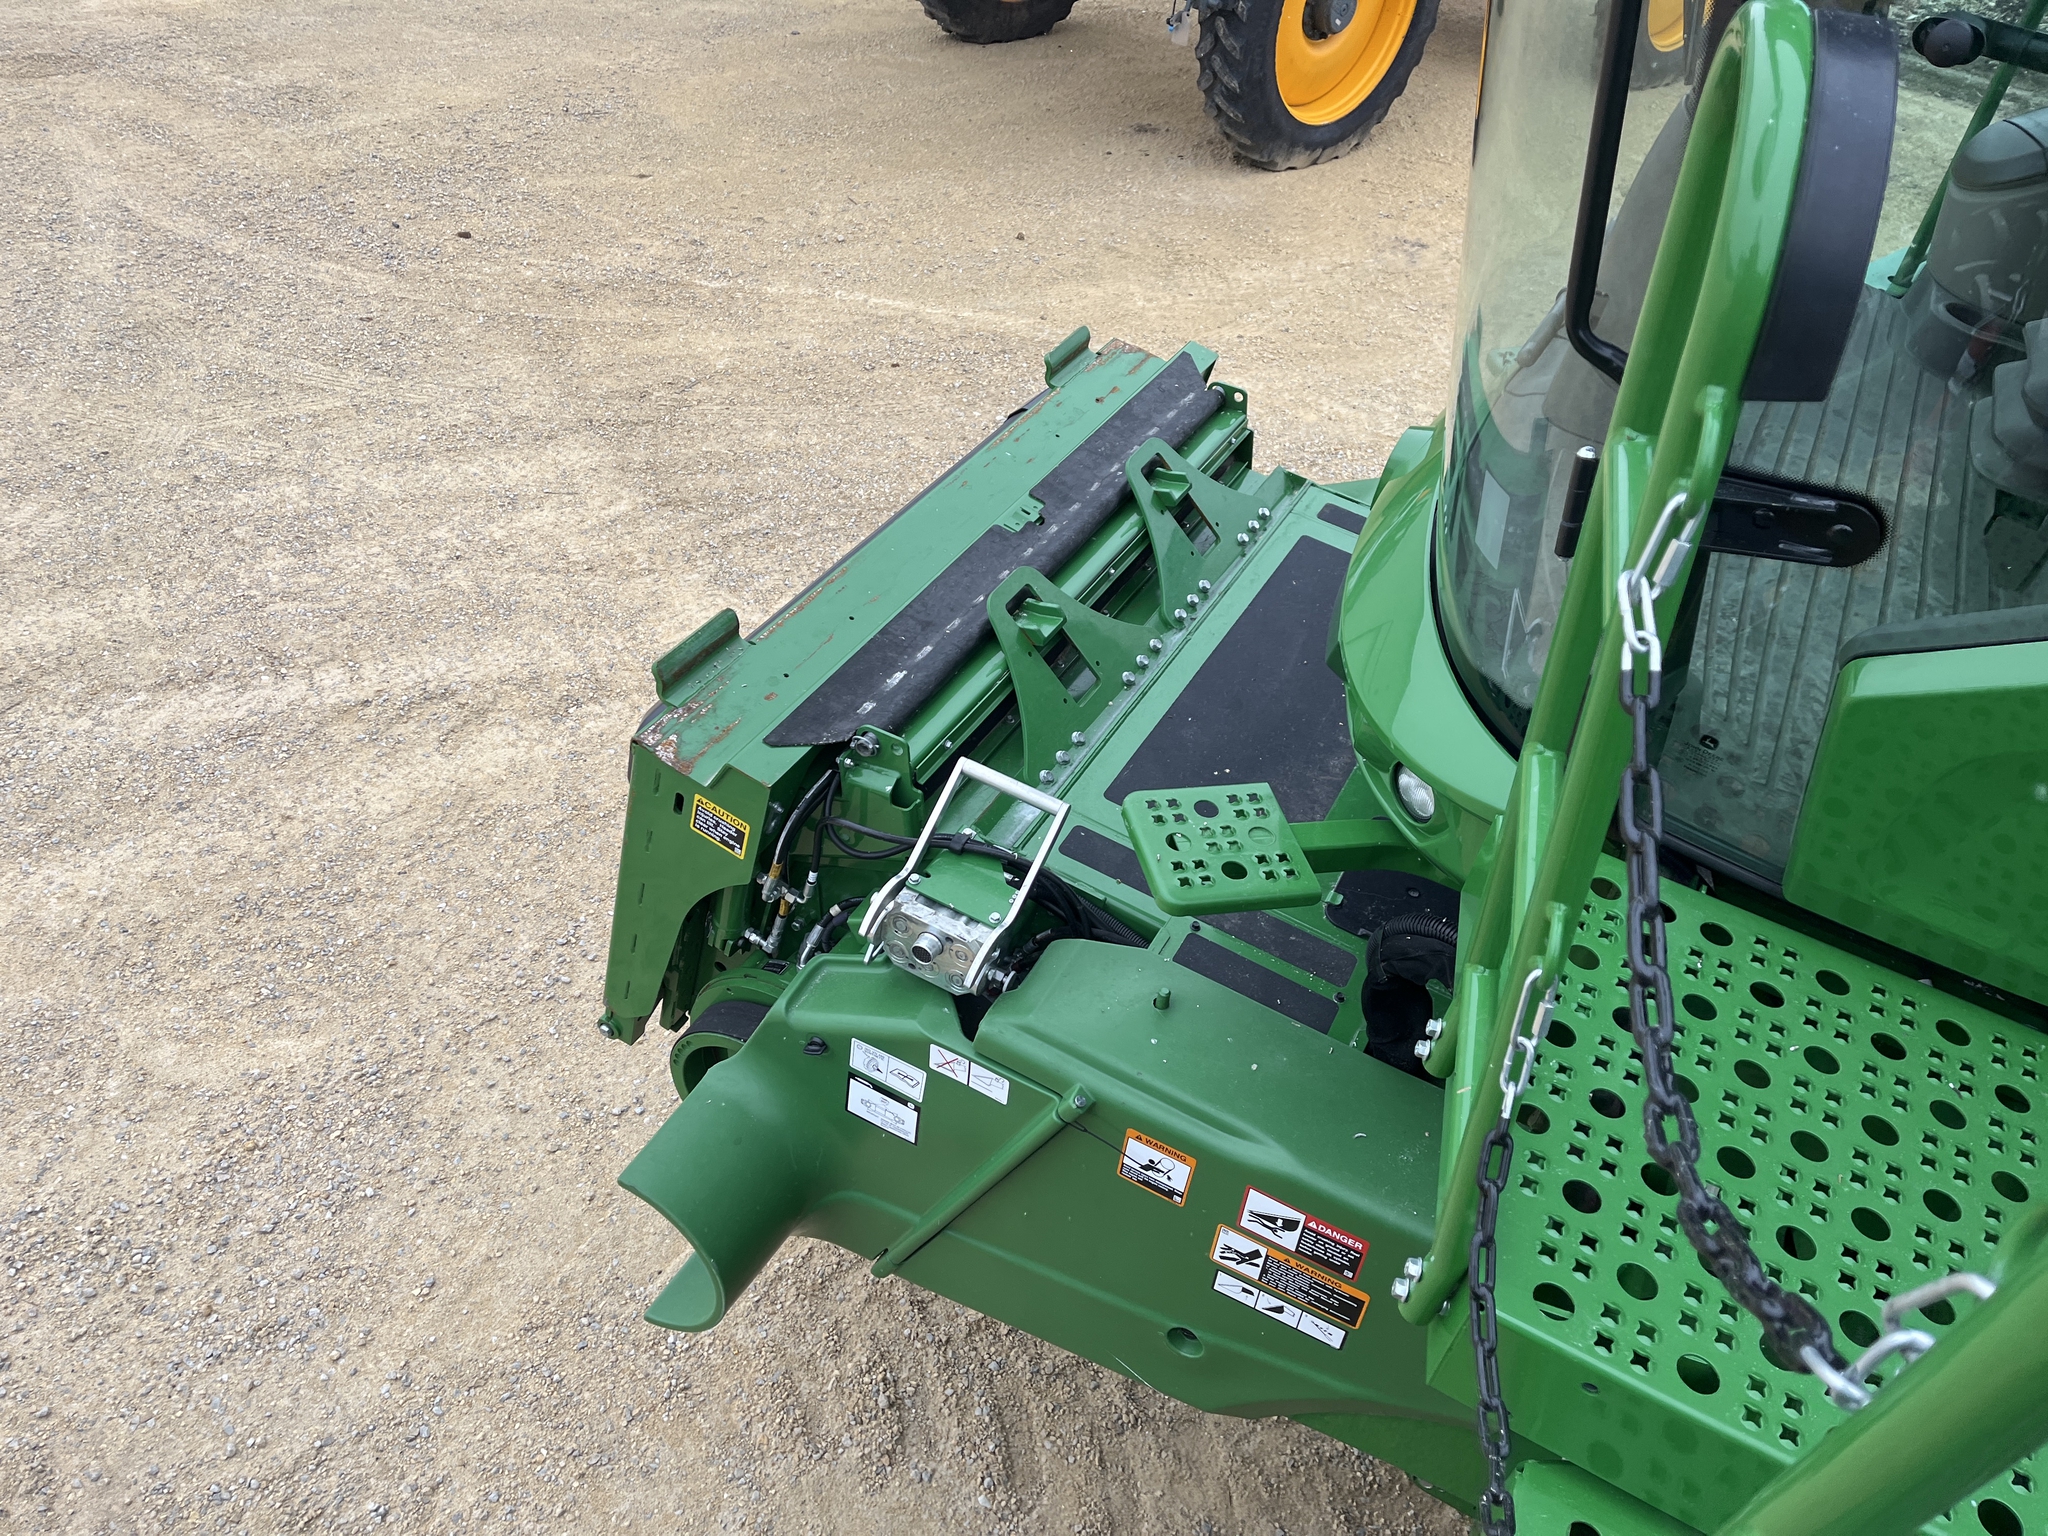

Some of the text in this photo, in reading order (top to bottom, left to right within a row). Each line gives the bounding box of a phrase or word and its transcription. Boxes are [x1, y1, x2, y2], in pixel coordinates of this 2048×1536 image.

[705, 802, 746, 831] CAUTION
[1146, 1138, 1186, 1162] WARNING
[1318, 1225, 1363, 1250] DANGER
[1296, 1262, 1342, 1288] WARNING
